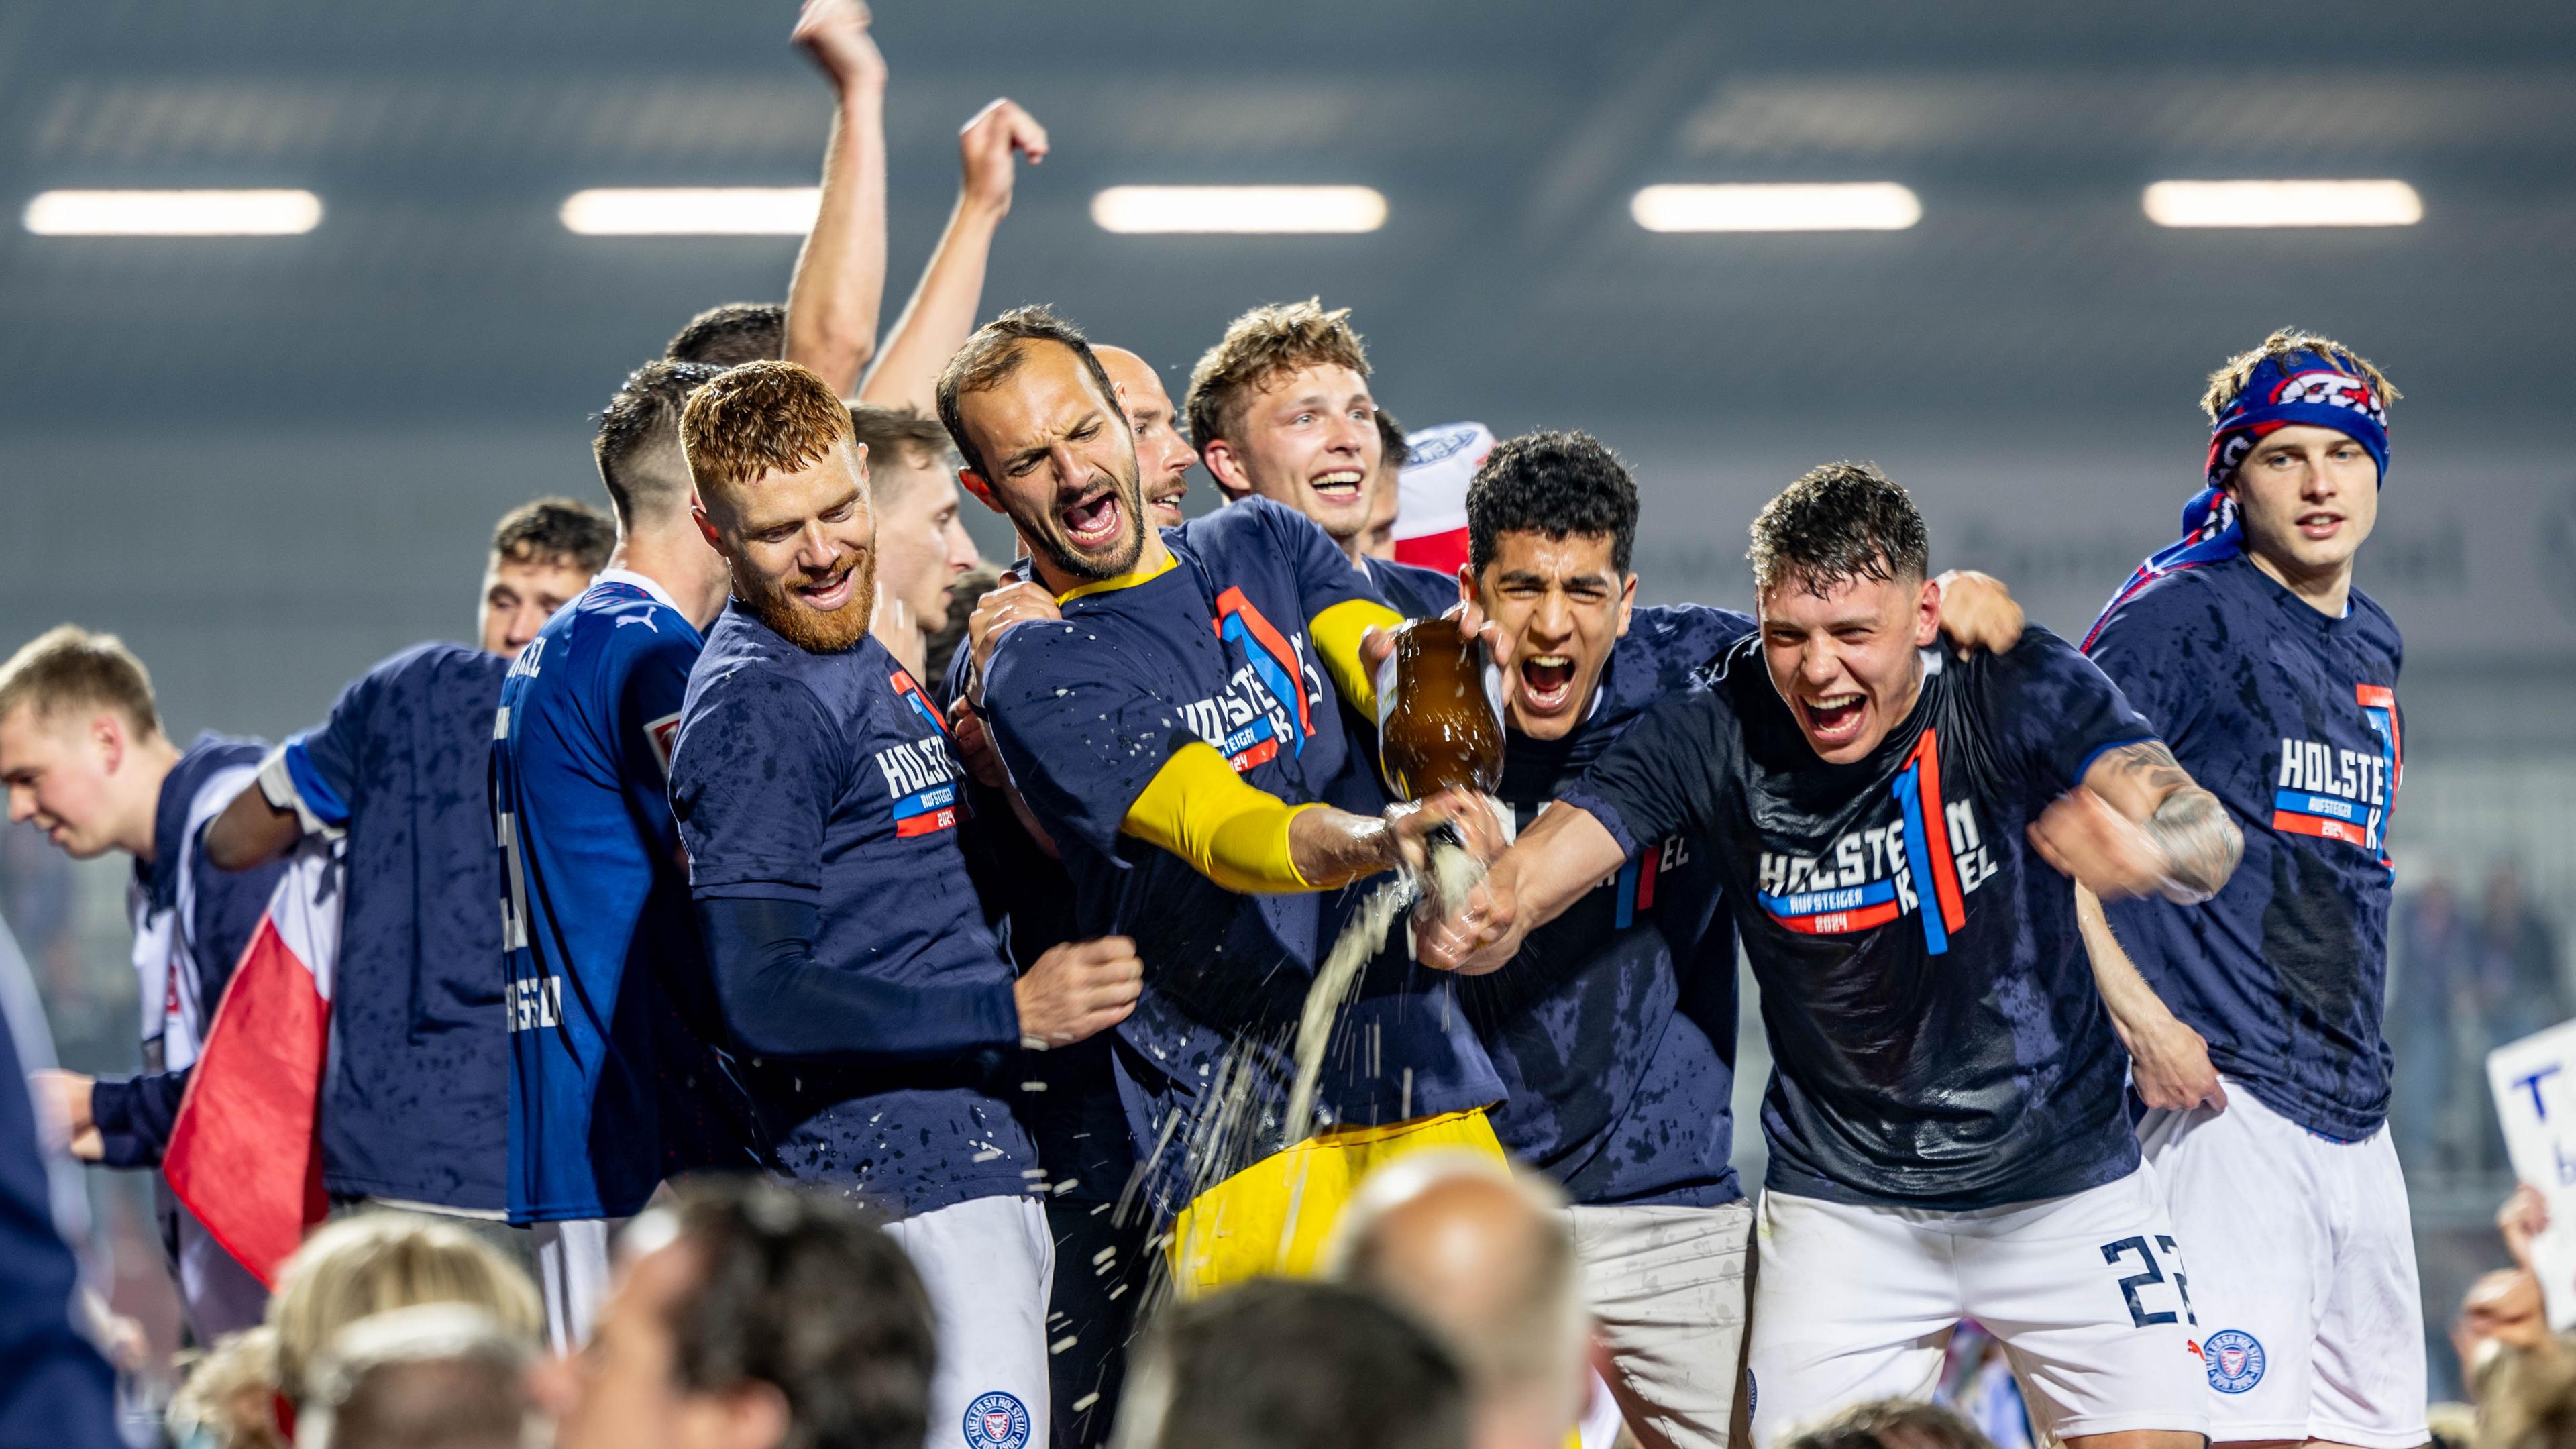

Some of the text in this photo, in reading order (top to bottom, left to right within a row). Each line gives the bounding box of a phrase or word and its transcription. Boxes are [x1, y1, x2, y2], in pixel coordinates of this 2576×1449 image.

[938, 810, 955, 828] 2024
[1790, 888, 1863, 914] AUFSTEIGER
[1815, 913, 1848, 933] 2024
[969, 1397, 1025, 1437] KIELER SV HOLSTEIN
